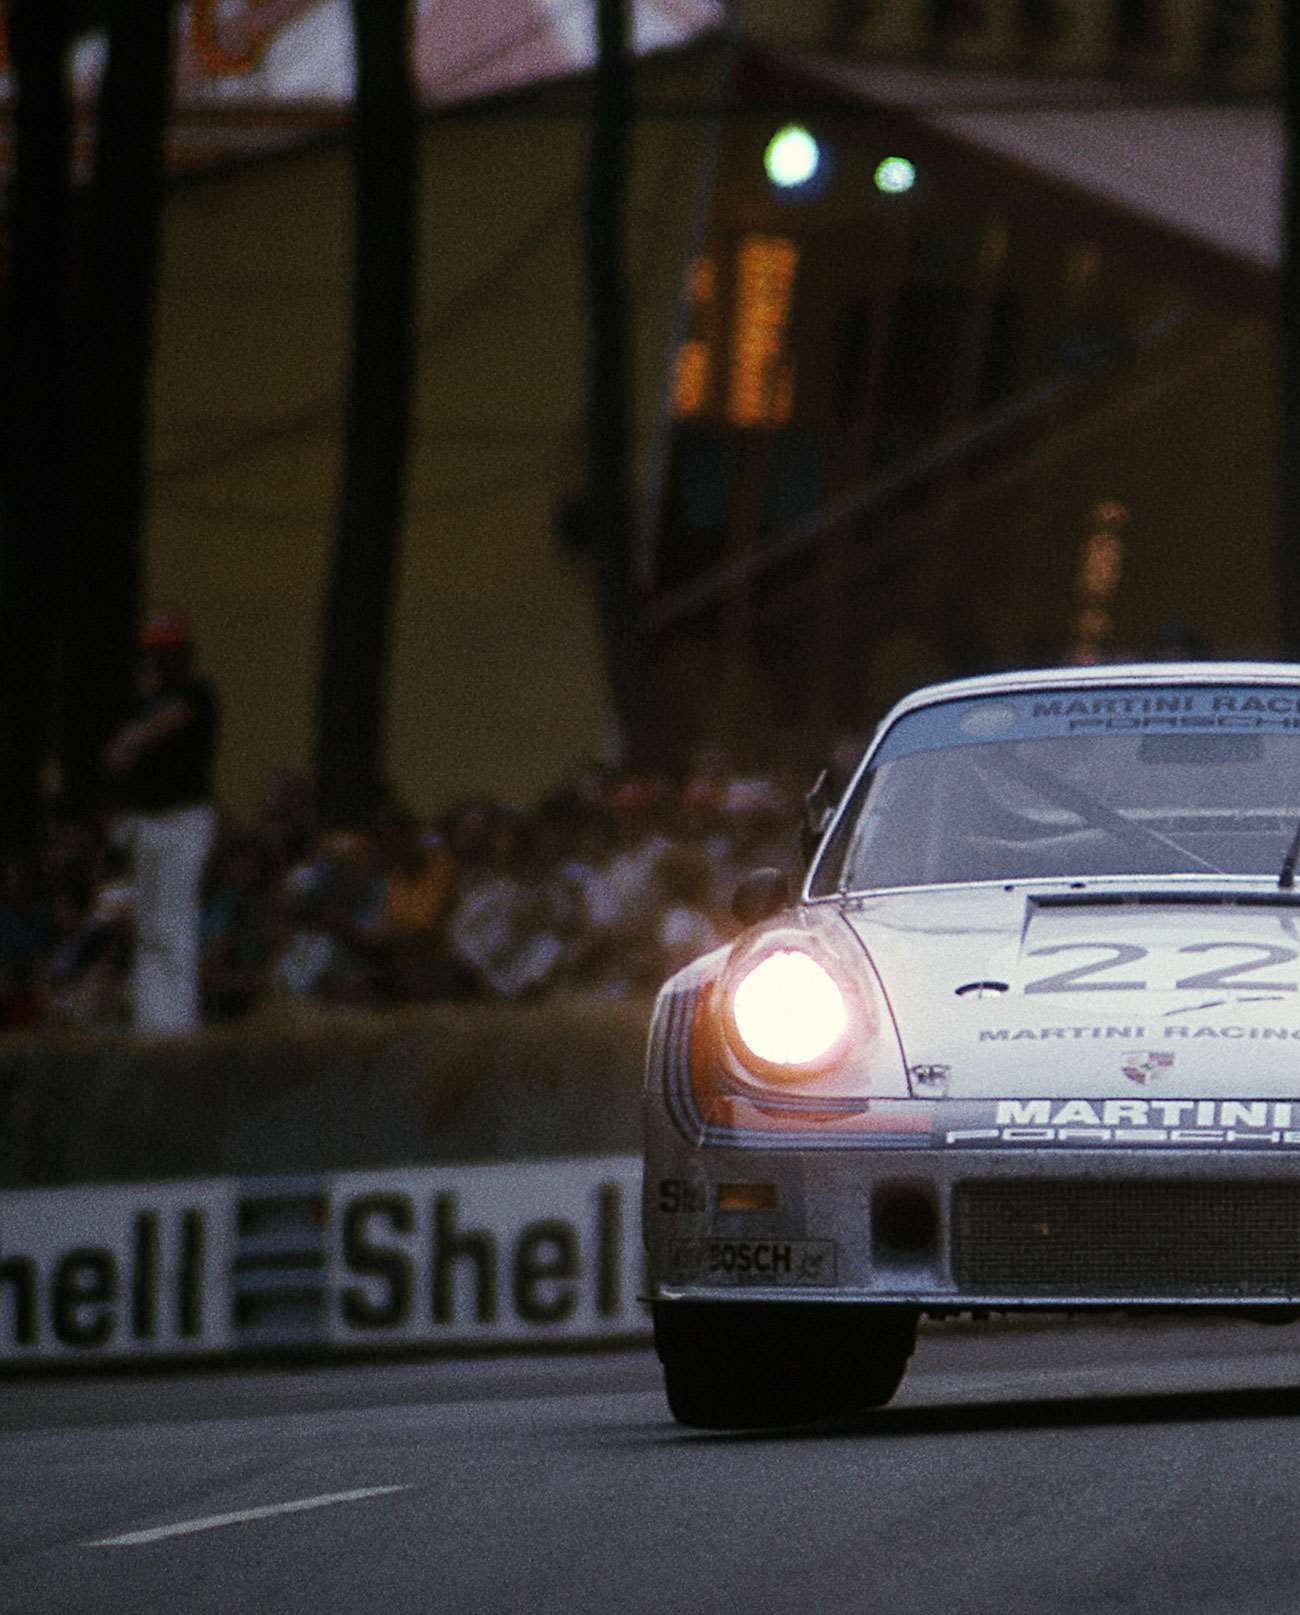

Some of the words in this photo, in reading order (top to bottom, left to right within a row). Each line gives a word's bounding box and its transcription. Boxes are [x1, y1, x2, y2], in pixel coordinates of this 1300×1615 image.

[1033, 695, 1194, 717] MARTINI
[1024, 942, 1300, 994] 22
[978, 1026, 1146, 1042] MARTINI
[997, 1101, 1292, 1128] MARTINI
[342, 1180, 630, 1328] Shel
